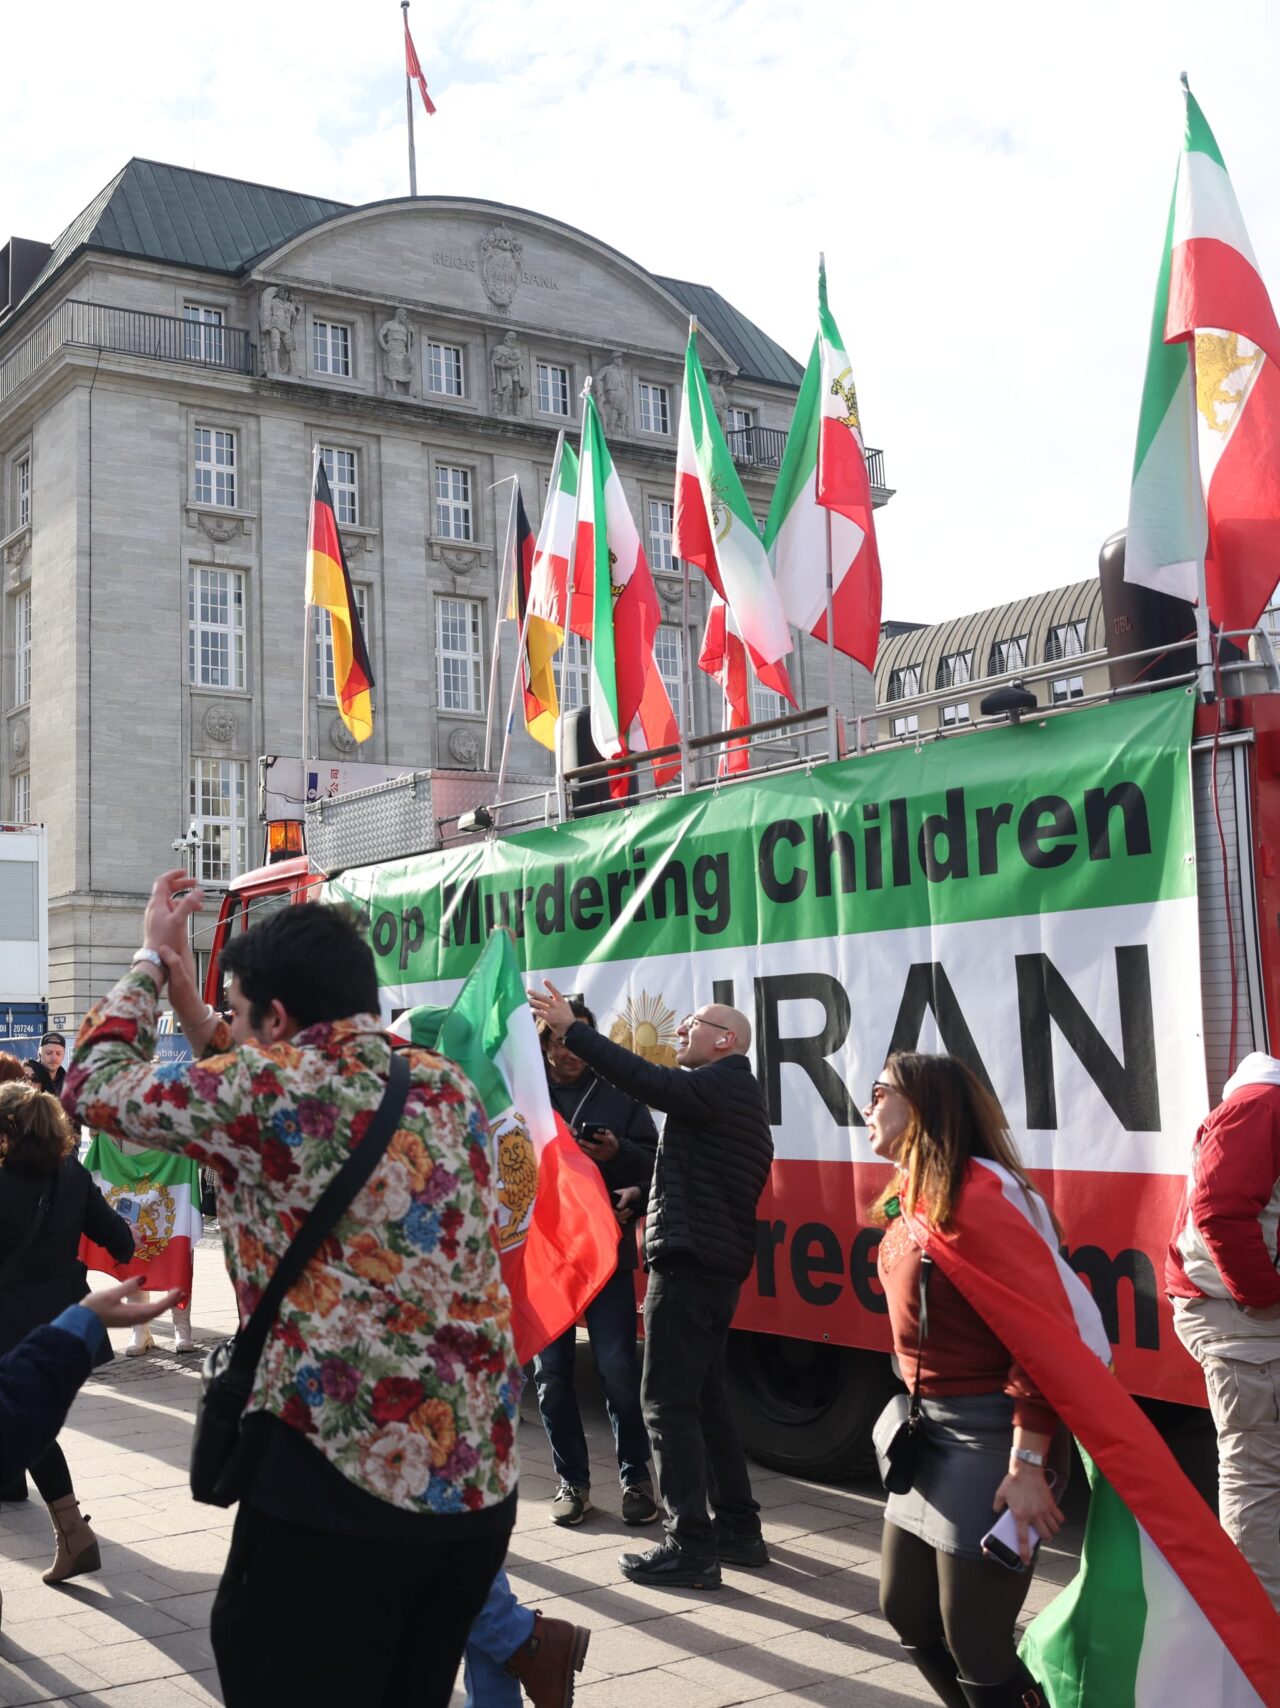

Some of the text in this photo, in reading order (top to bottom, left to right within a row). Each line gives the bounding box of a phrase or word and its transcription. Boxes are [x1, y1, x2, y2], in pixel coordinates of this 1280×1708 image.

[433, 251, 561, 291] REICHS BANK
[1114, 615, 1131, 634] JBL
[372, 781, 1152, 971] op Murdering Children
[13, 1024, 34, 1033] 207246
[713, 944, 1162, 1132] RAN
[156, 1048, 179, 1057] sbau
[756, 1216, 1160, 1351] reem
